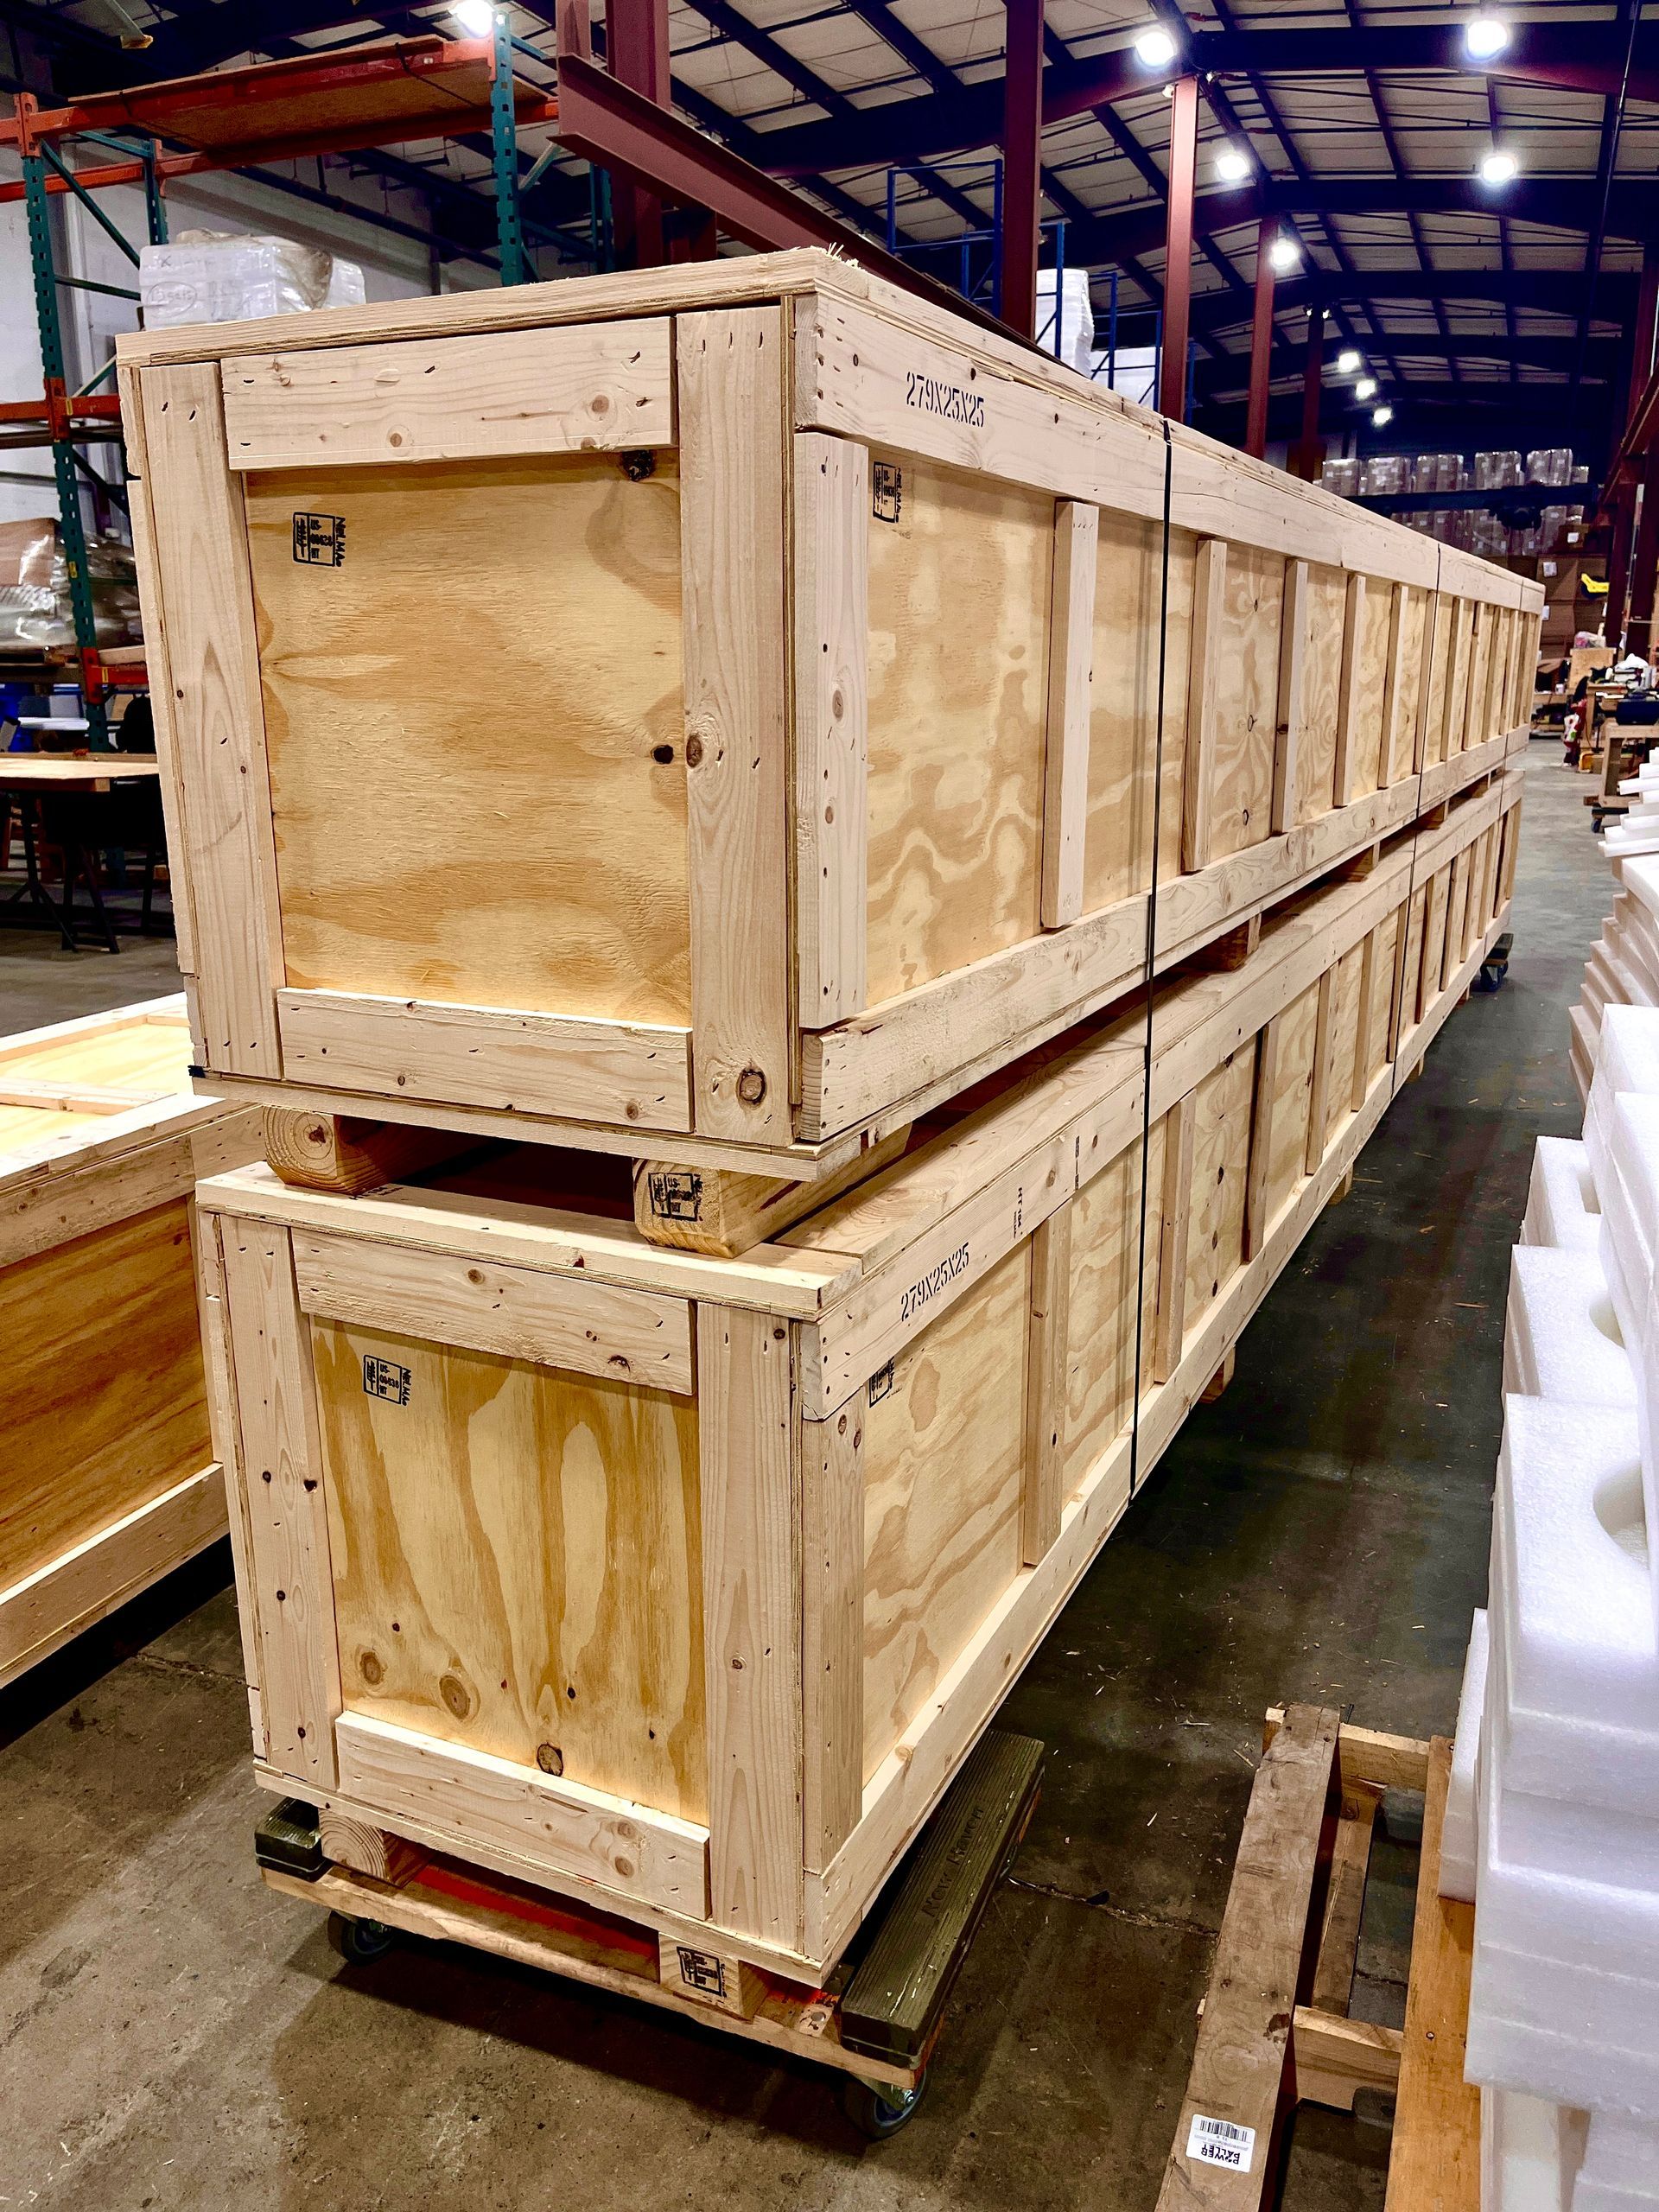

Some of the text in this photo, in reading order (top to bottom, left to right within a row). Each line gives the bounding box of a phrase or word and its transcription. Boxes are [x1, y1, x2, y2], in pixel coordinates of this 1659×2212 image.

[906, 372, 984, 428] 279X25X25
[900, 1242, 969, 1322] 279X25X25
[1201, 2144, 1241, 2158] PALLET
[1201, 2147, 1240, 2164] POWER
